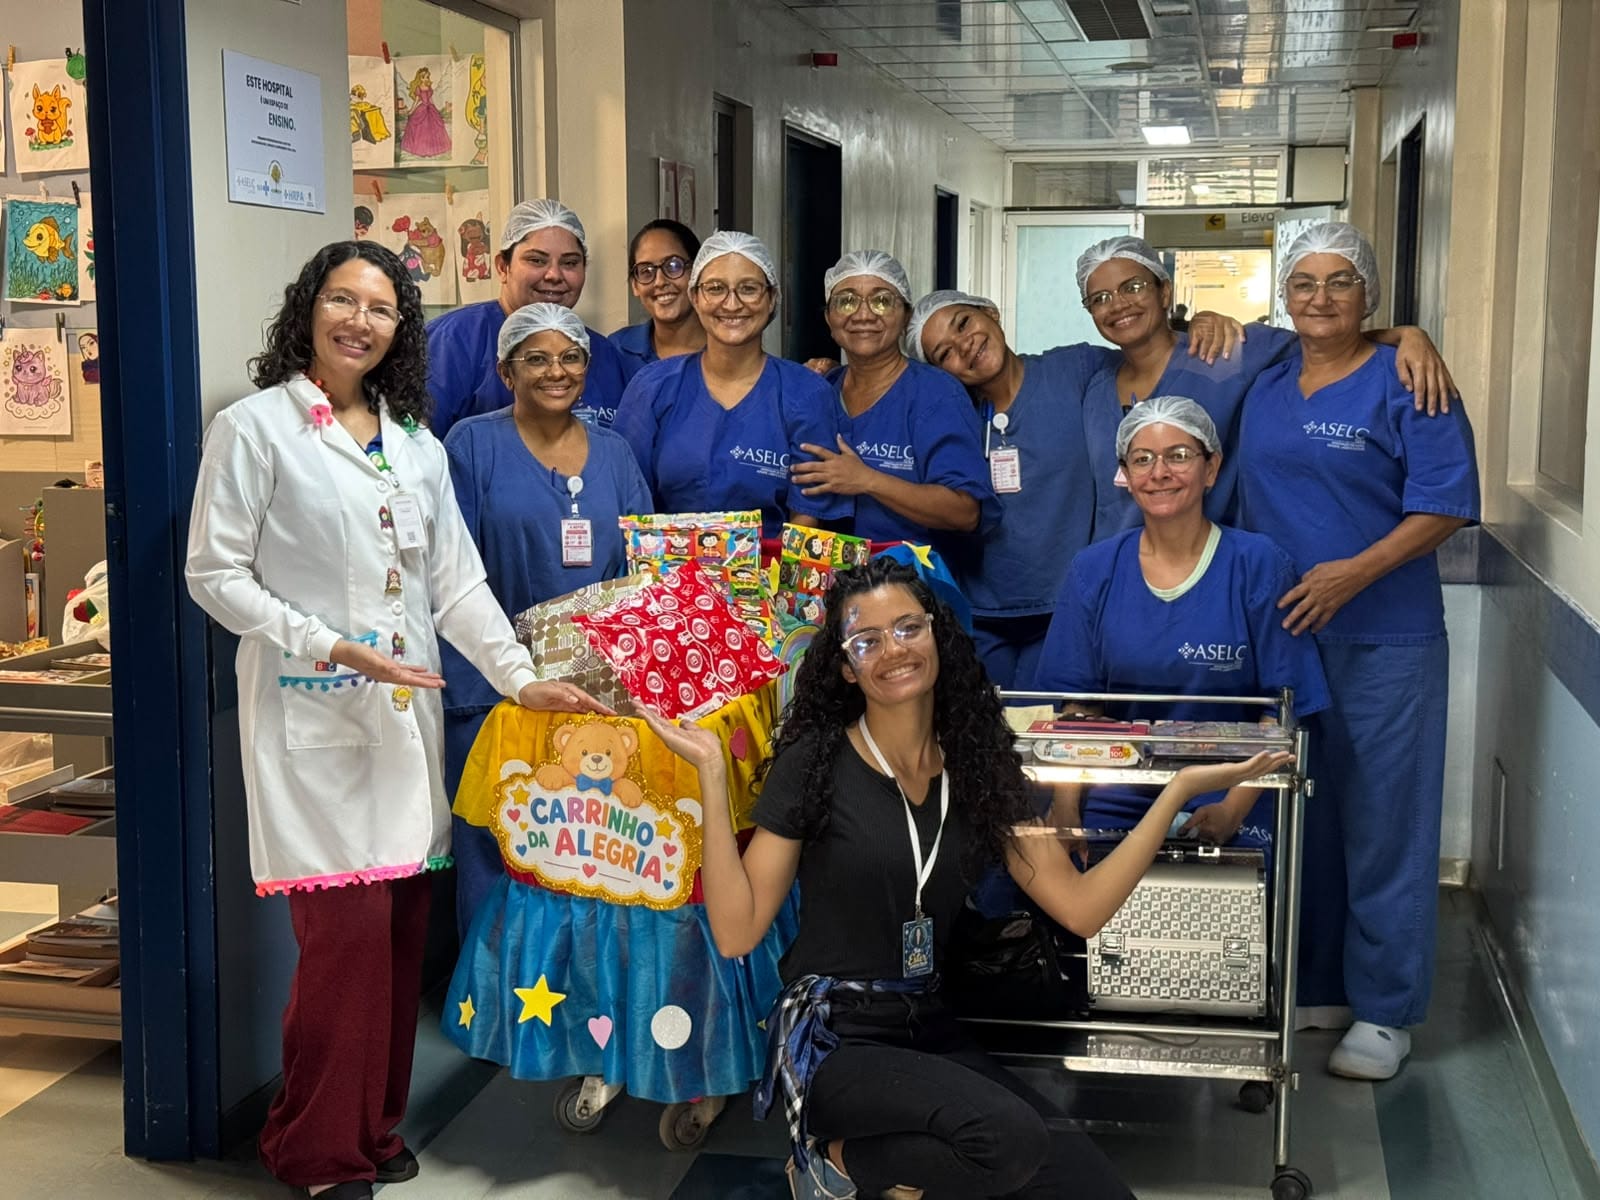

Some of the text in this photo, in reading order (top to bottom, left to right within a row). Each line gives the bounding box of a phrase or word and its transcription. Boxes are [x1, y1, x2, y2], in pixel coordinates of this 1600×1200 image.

[246, 74, 293, 98] ESTE HOSPITAL
[269, 112, 296, 131] ENSINO.
[1314, 422, 1370, 440] ASELC
[743, 447, 790, 468] ASELC
[867, 442, 913, 460] ASELC
[1193, 643, 1248, 661] ASELC
[530, 796, 655, 847] CARRINHO
[527, 827, 661, 884] DA ALEGRIA
